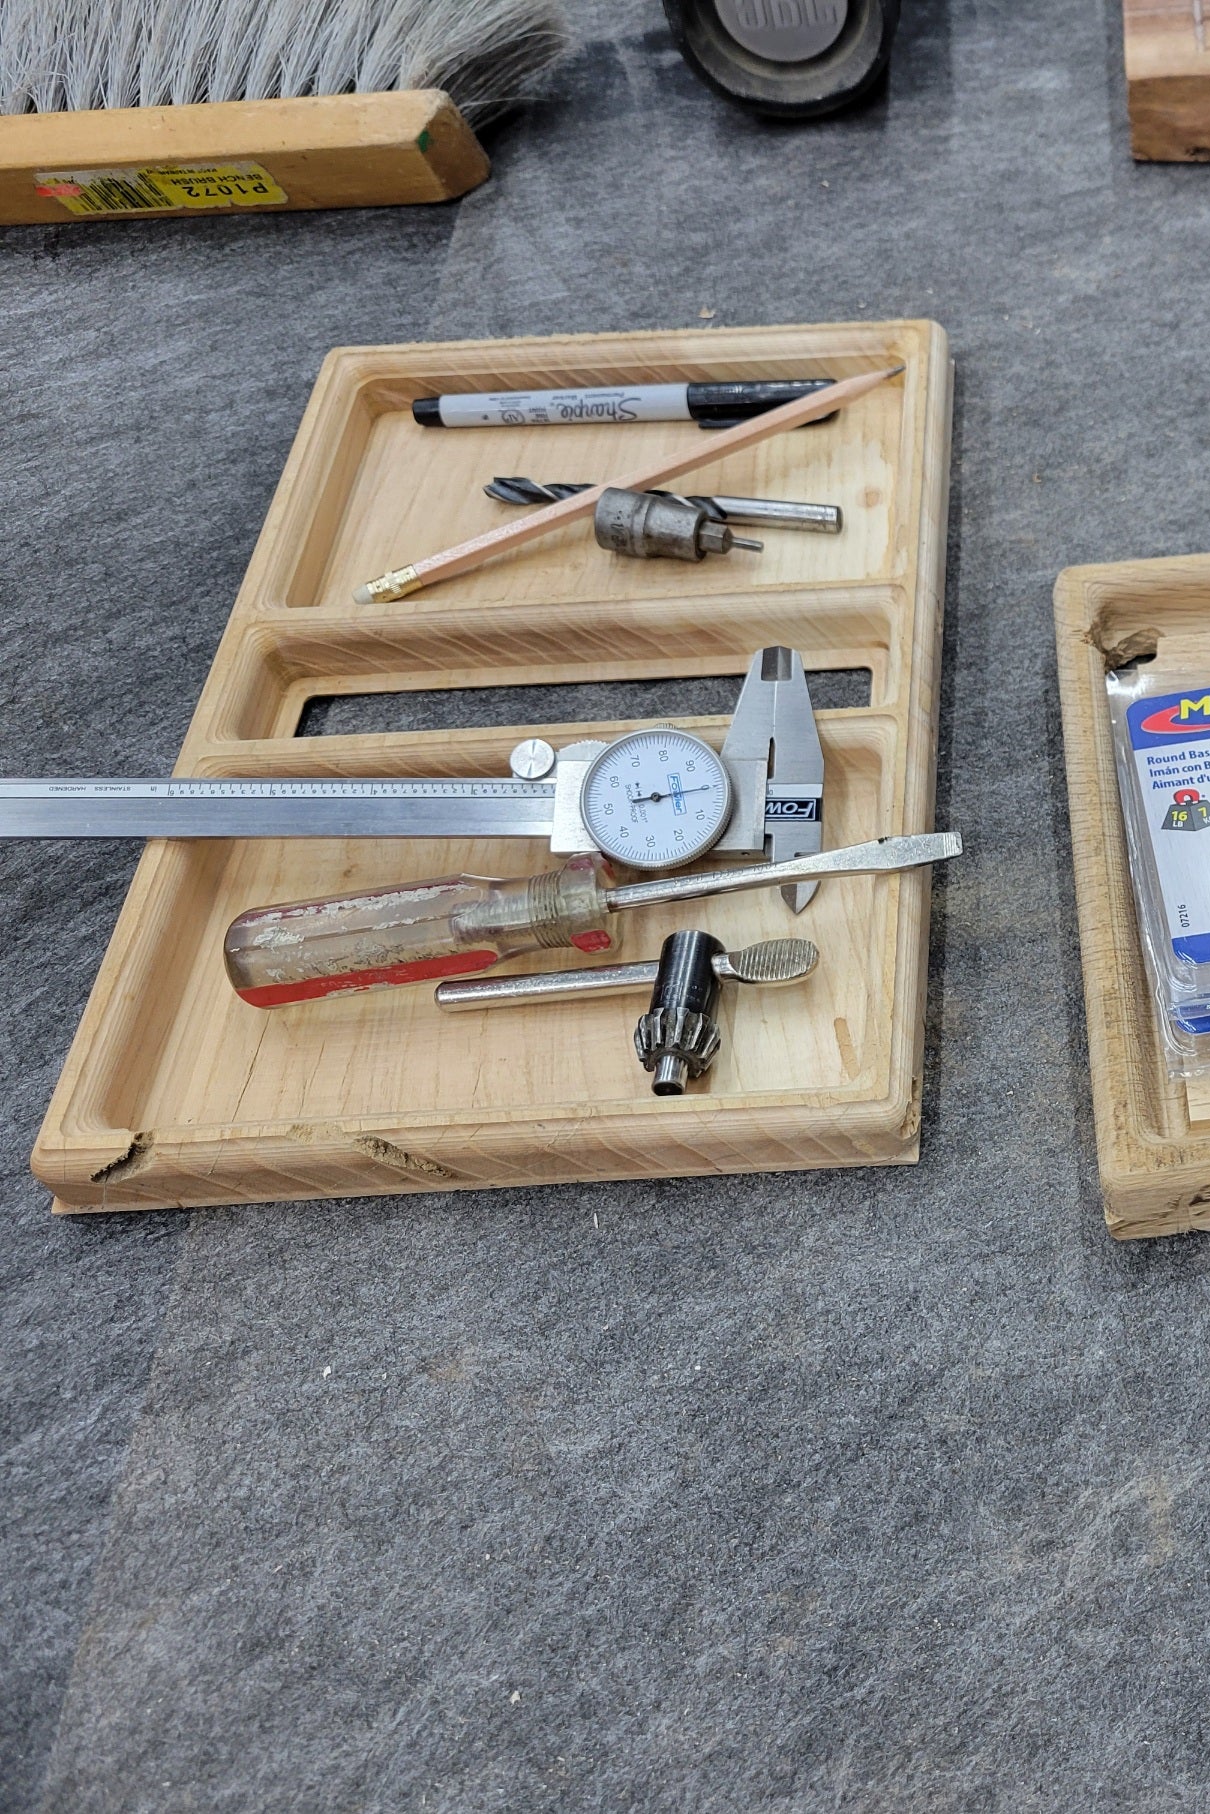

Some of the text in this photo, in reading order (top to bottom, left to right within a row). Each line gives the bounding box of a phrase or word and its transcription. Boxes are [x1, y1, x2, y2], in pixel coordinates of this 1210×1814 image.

[170, 173, 263, 186] BENCH BRUSH
[182, 182, 269, 198] P1072
[556, 397, 642, 421] Sharpie
[631, 754, 641, 768] 70
[658, 750, 668, 762] 80
[1147, 752, 1187, 766] Round
[685, 759, 696, 772] 90
[1150, 766, 1180, 777] Imán
[1182, 764, 1201, 774] con
[609, 776, 620, 789] 60
[1152, 776, 1195, 790] Aimant
[670, 775, 683, 813] Fowler
[603, 803, 614, 816] 50
[696, 809, 705, 821] 10
[1197, 807, 1207, 817] 7
[1171, 811, 1188, 828] 16 LB
[619, 826, 629, 839] 40
[674, 829, 684, 842] 20
[646, 835, 656, 848] 30
[1178, 904, 1190, 928] 07216
